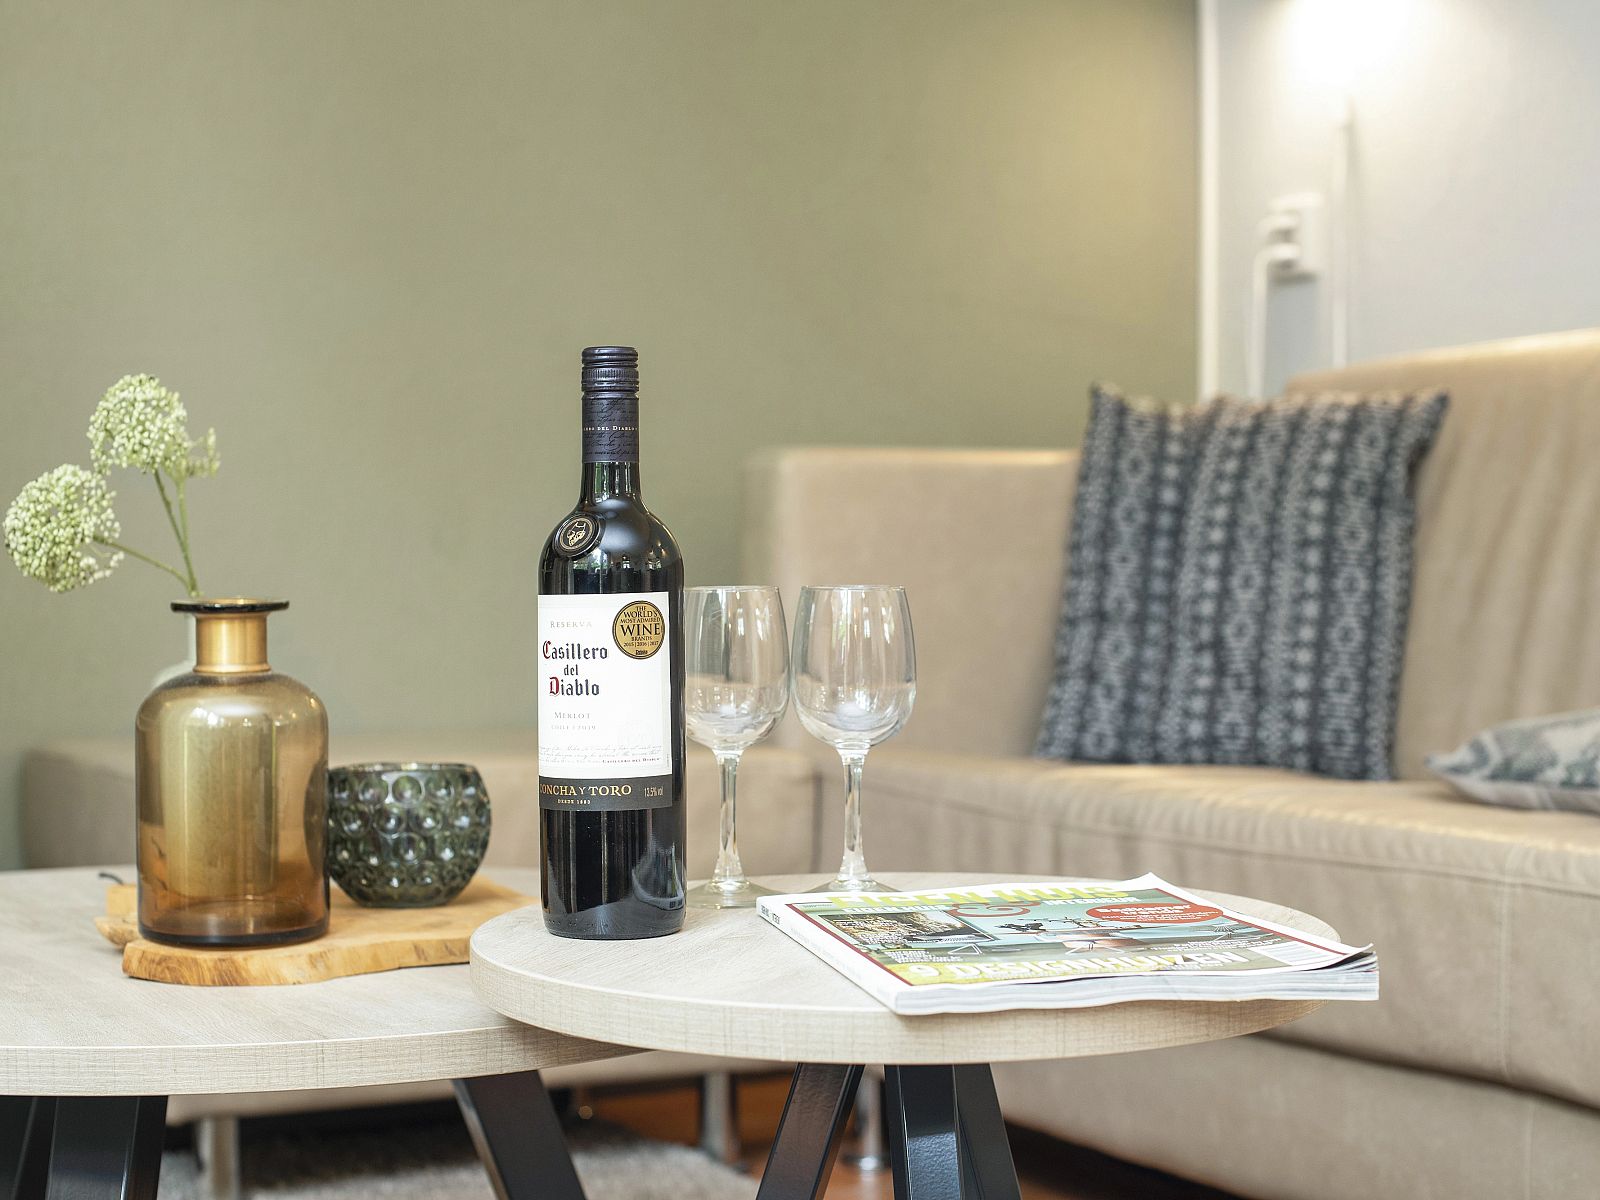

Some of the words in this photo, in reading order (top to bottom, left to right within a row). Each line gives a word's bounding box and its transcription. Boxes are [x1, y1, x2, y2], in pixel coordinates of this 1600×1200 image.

[620, 623, 662, 636] WINE
[543, 640, 608, 660] Casillero
[563, 664, 579, 676] del
[549, 677, 600, 696] Diablo
[554, 711, 591, 719] MERLOT
[578, 786, 586, 794] Y
[587, 785, 632, 796] TORO
[991, 886, 1129, 903] HUIS
[908, 964, 941, 977] 9
[945, 952, 1250, 977] DESIGNHUIZEN
